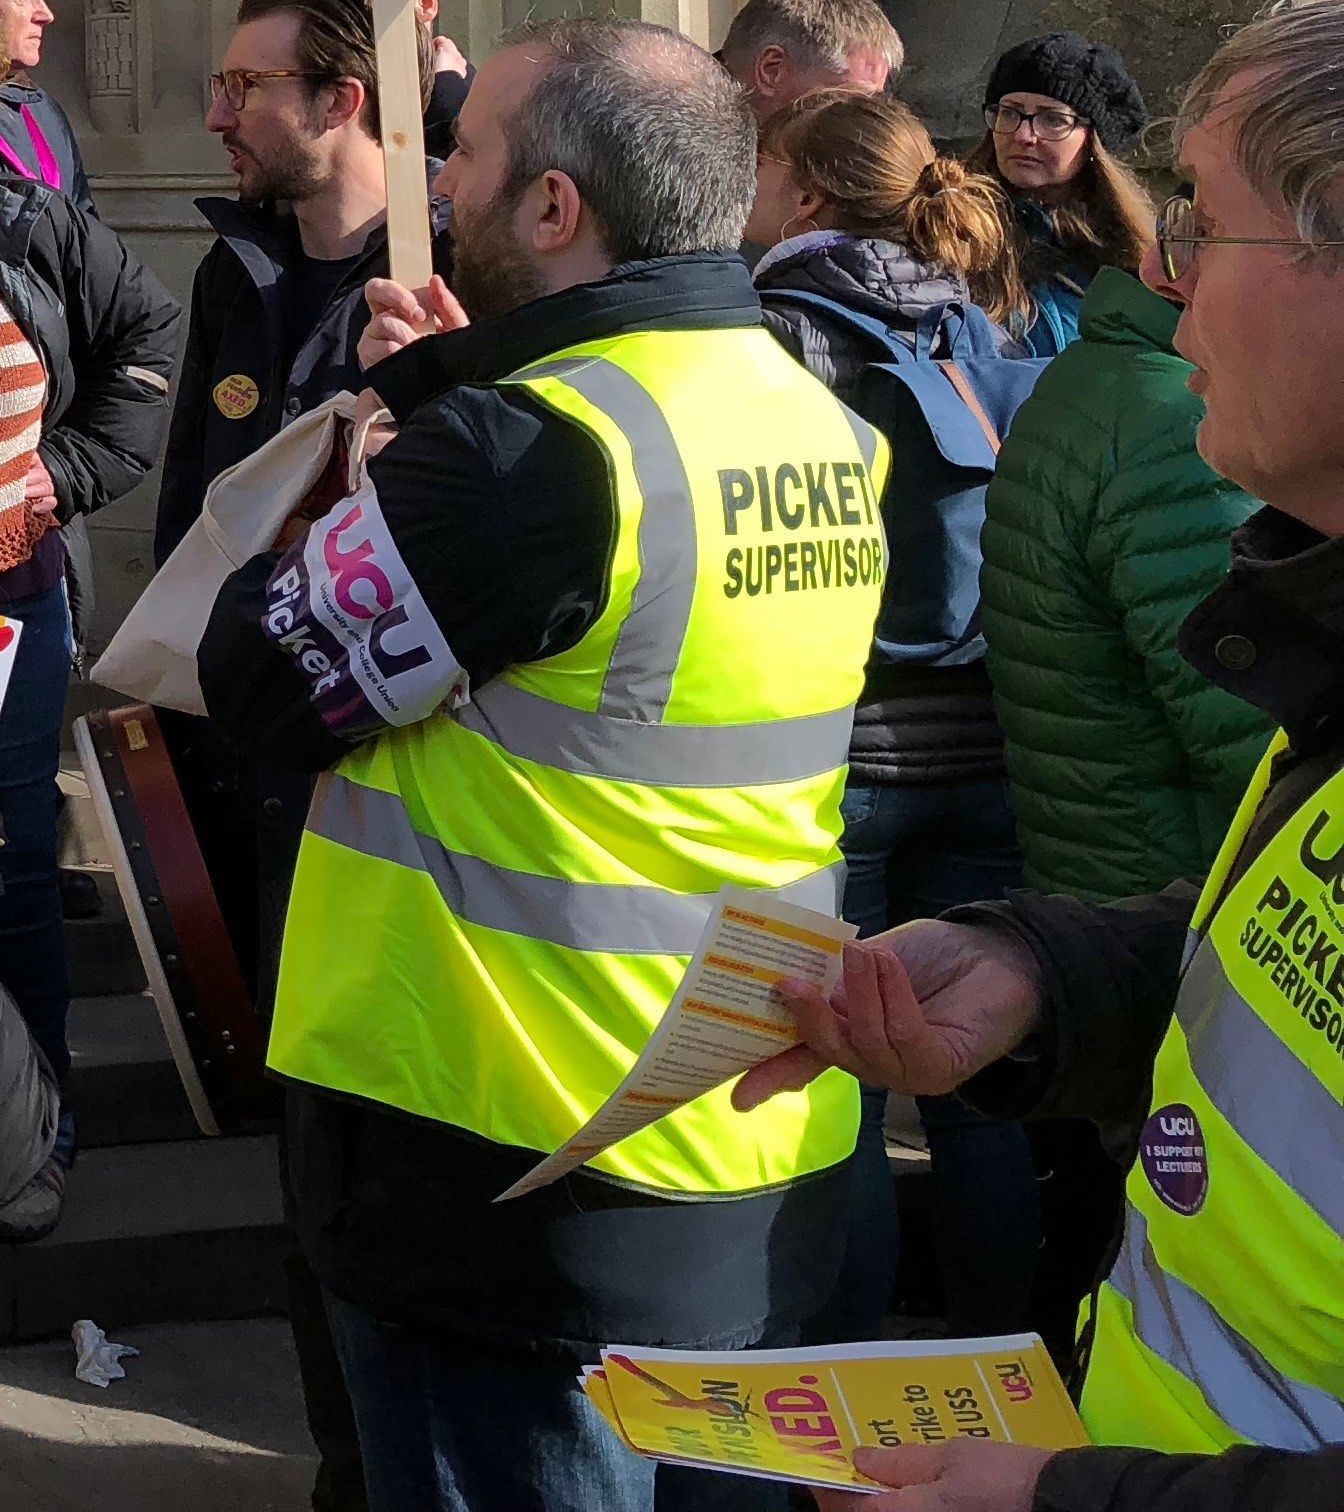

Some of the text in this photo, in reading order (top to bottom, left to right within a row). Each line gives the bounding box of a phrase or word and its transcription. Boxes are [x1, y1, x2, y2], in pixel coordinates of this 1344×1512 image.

[717, 462, 874, 536] PICKET
[723, 537, 883, 599] SUPERVISOR
[268, 564, 341, 695] Picket
[320, 583, 350, 630] University
[376, 684, 400, 713] Union
[764, 1374, 849, 1465] XED.
[903, 1384, 930, 1404] to
[944, 1386, 983, 1423] USS
